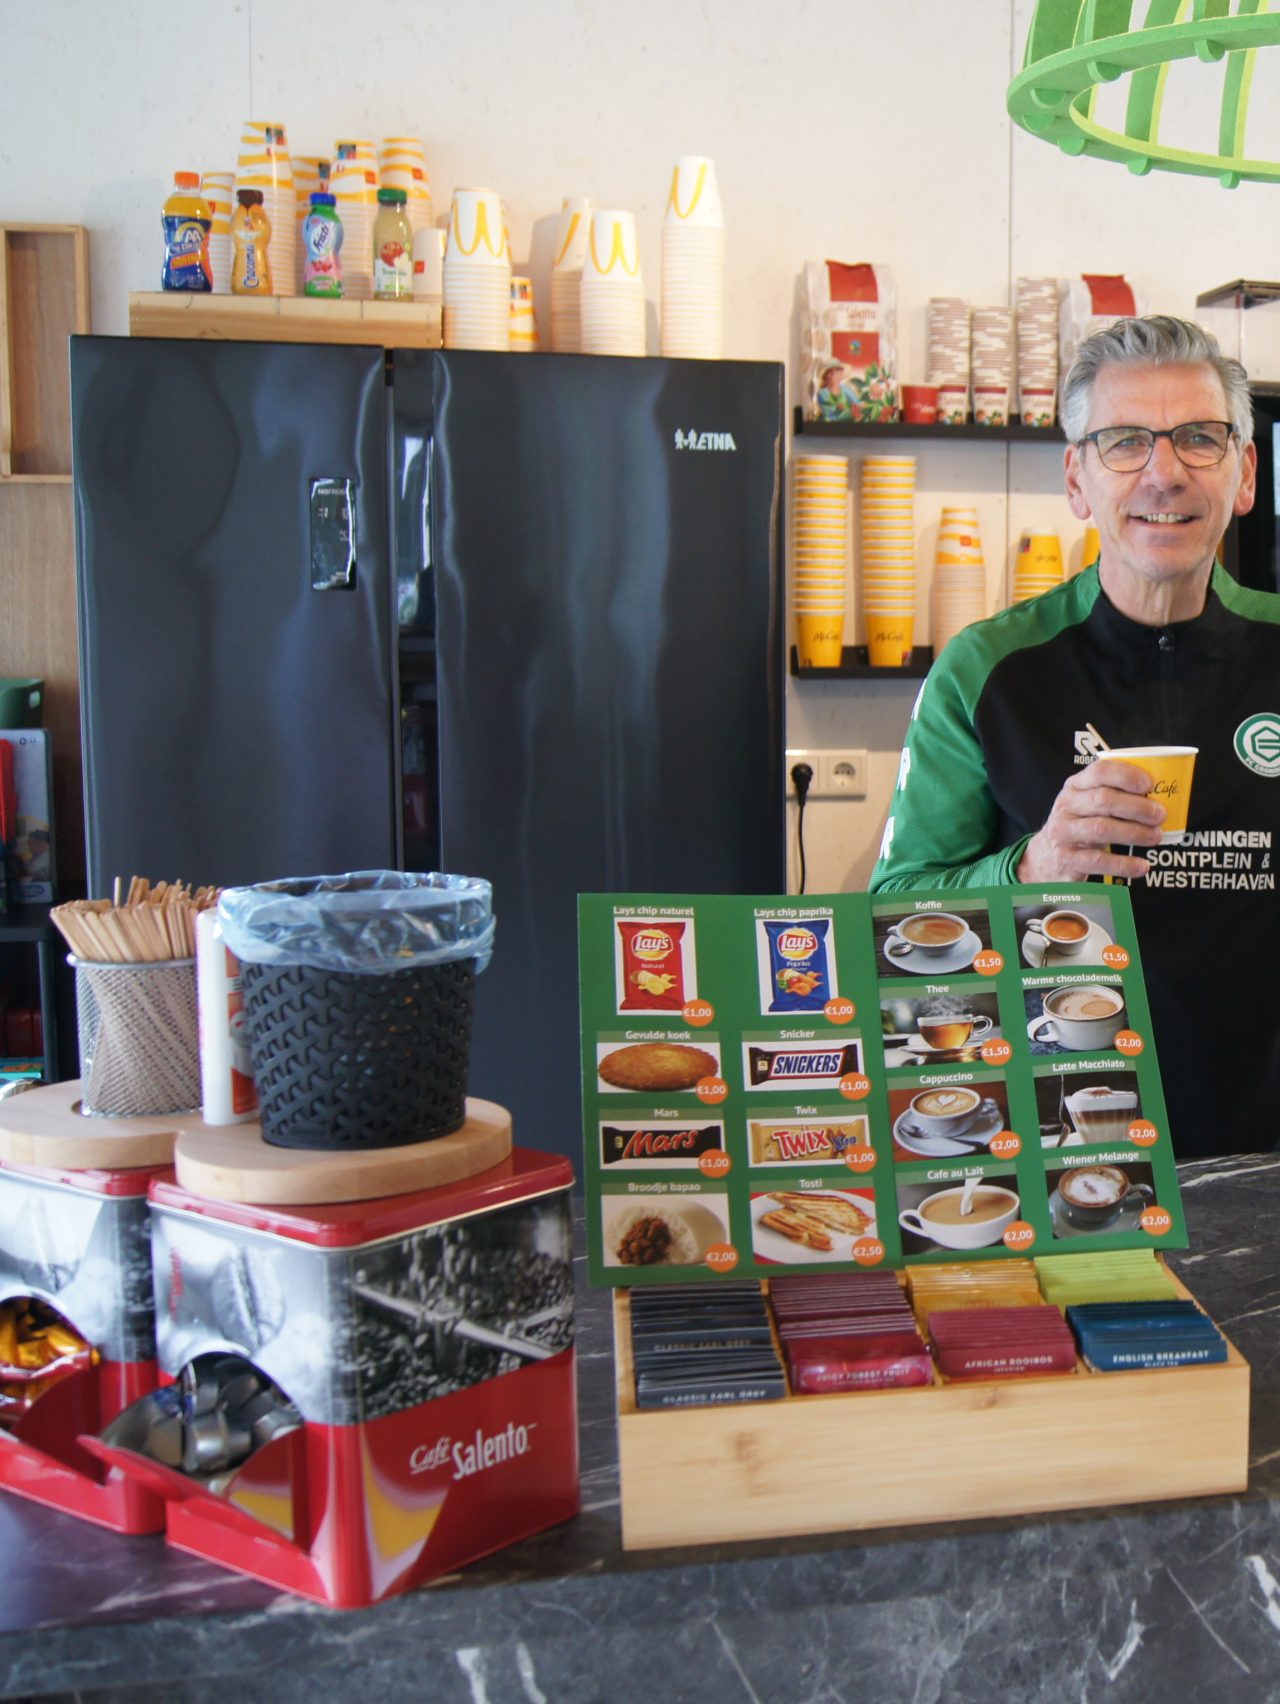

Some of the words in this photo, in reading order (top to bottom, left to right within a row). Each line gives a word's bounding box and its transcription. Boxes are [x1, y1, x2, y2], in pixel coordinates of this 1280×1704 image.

[696, 431, 737, 451] ETNA
[1172, 830, 1272, 848] ONINGEN
[1146, 850, 1252, 869] SONTPLEIN
[1261, 852, 1270, 869] &
[1144, 871, 1275, 890] WESTERHAVEN
[1042, 893, 1081, 904] Espresso
[915, 900, 942, 910] Koffie
[613, 906, 636, 915] Lays
[637, 906, 657, 916] chip
[659, 907, 695, 916] naturel
[754, 908, 775, 917] Lays
[776, 908, 797, 918] chip
[799, 907, 833, 917] paprika
[974, 957, 1002, 968] €1,50
[1103, 951, 1128, 963] €1,50
[1022, 975, 1055, 986] Warme
[1056, 973, 1123, 984] chocolademelk
[925, 984, 949, 994] Thee
[683, 1007, 712, 1018] €1,00
[824, 1005, 853, 1016] €1,00
[625, 1030, 665, 1041] Gevulde
[666, 1030, 691, 1040] koek
[780, 1029, 815, 1040] Snicker
[1115, 1037, 1142, 1049] €2,00
[982, 1046, 1010, 1057] €1,50
[773, 1054, 841, 1075] SNICKERS
[1052, 1060, 1077, 1072] Latte
[1078, 1059, 1125, 1070] Macchiato
[919, 1072, 974, 1086] Cappuccino
[697, 1085, 726, 1096] €1,00
[839, 1080, 869, 1091] €1,00
[653, 1108, 679, 1118] Mars
[794, 1105, 817, 1115] Twix
[1129, 1128, 1156, 1139] €2,00
[621, 1130, 699, 1160] Mars
[773, 1130, 832, 1160] TWIX
[990, 1139, 1019, 1150] €2,00
[700, 1158, 729, 1169] €1,00
[846, 1152, 874, 1164] €1,00
[1062, 1154, 1097, 1165] Wiener
[1098, 1151, 1139, 1164] Melange
[927, 1169, 951, 1180] Cafe
[952, 1170, 964, 1178] au
[965, 1166, 984, 1177] Lait
[627, 1182, 668, 1194] Broodje
[669, 1182, 701, 1193] bapao
[799, 1178, 823, 1189] Tosti
[1141, 1215, 1170, 1226] €2,00
[1003, 1230, 1033, 1241] €2,00
[705, 1251, 736, 1263] €2,00
[853, 1246, 882, 1257] €2,50
[965, 1359, 1008, 1369] AFRICAN
[1009, 1355, 1053, 1366] ROOIBOS
[1113, 1353, 1154, 1363] ENGLISH
[1156, 1350, 1209, 1361] BREAKFAST
[662, 1393, 707, 1404] CLASSIC
[710, 1391, 736, 1401] EARL
[738, 1389, 766, 1399] GREY
[409, 1436, 451, 1472] Café
[452, 1421, 529, 1481] Salento
